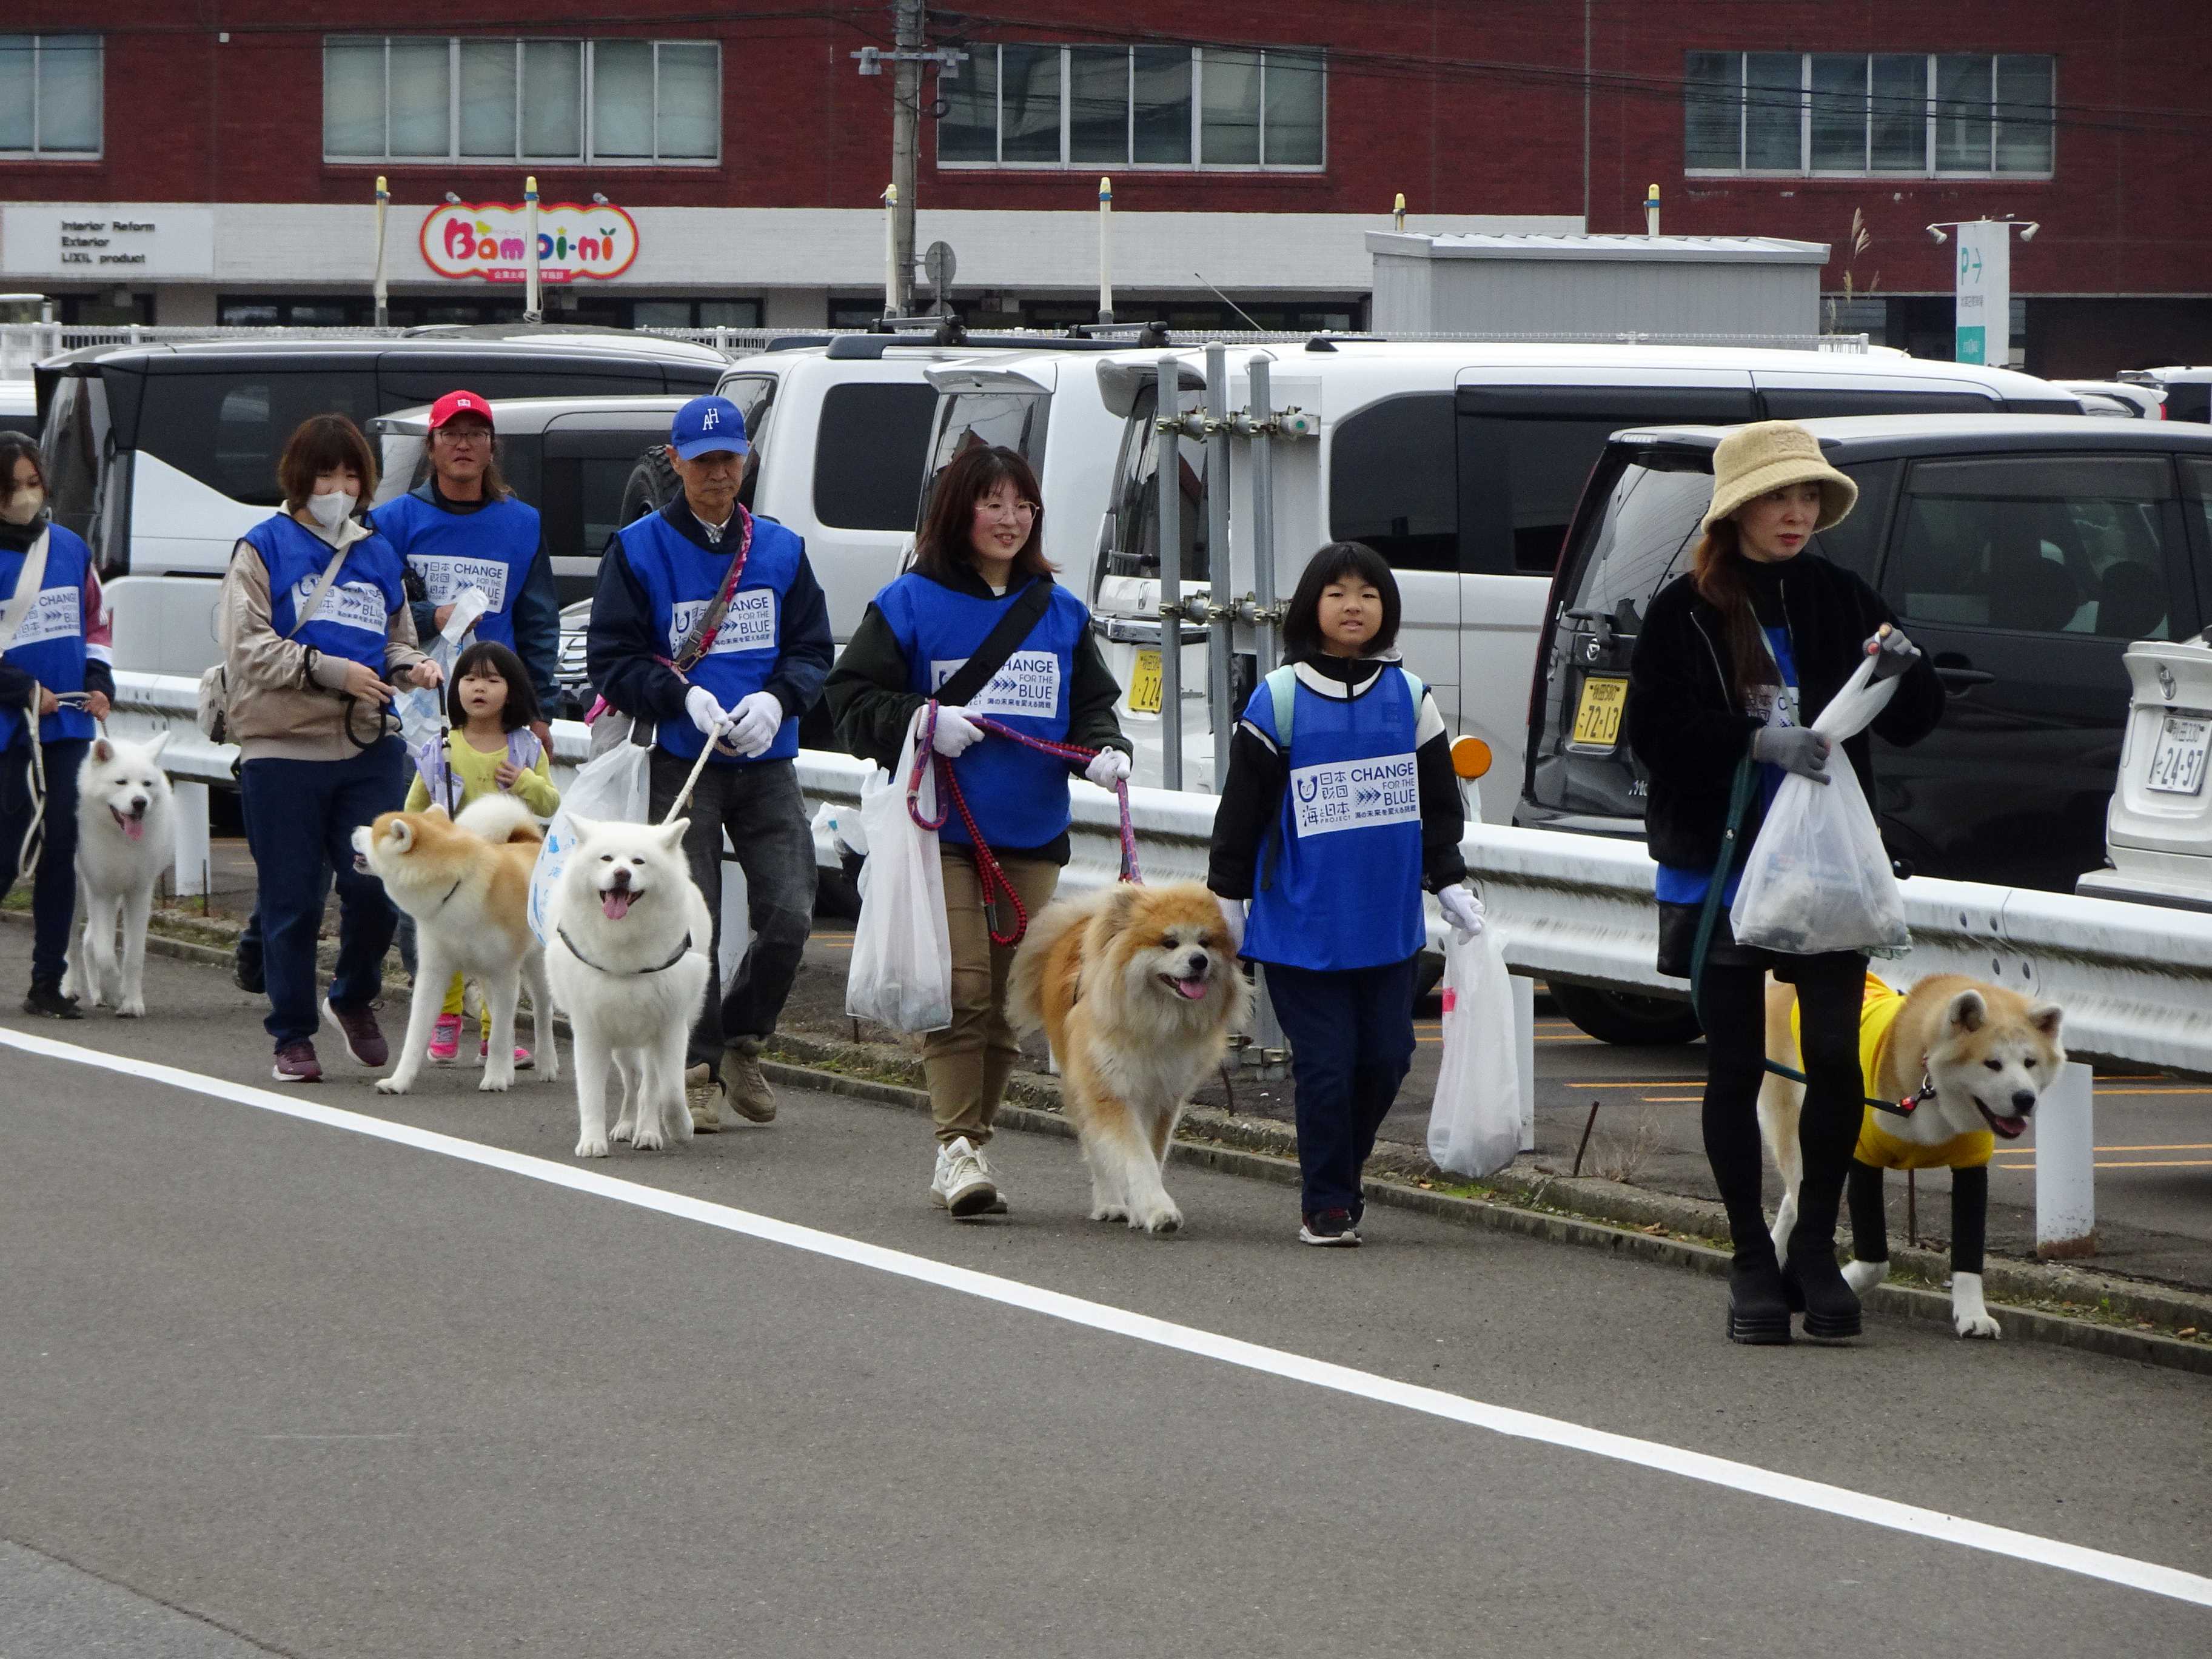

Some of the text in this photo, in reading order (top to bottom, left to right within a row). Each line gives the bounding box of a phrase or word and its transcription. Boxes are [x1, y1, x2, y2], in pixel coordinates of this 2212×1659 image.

[62, 221, 155, 231] Interior Reform
[62, 236, 110, 247] Exterior
[62, 252, 146, 264] LIXIL product
[430, 562, 449, 572] 日本
[454, 563, 503, 579] CHANGE
[727, 597, 769, 614] ANGE
[740, 620, 771, 634] BLUE
[1002, 659, 1053, 673] HANGE
[1019, 674, 1053, 685] FOR THE
[1019, 684, 1053, 700] BLUE
[1584, 705, 1619, 739] 72-13
[1351, 762, 1414, 782] CHANGE
[2161, 747, 2204, 788] 24-97
[1320, 771, 1347, 785] 日本
[1382, 778, 1415, 789] FOR THE
[1322, 785, 1349, 800] 財団
[1384, 788, 1416, 806] BLUE
[1320, 815, 1351, 823] PROJECT
